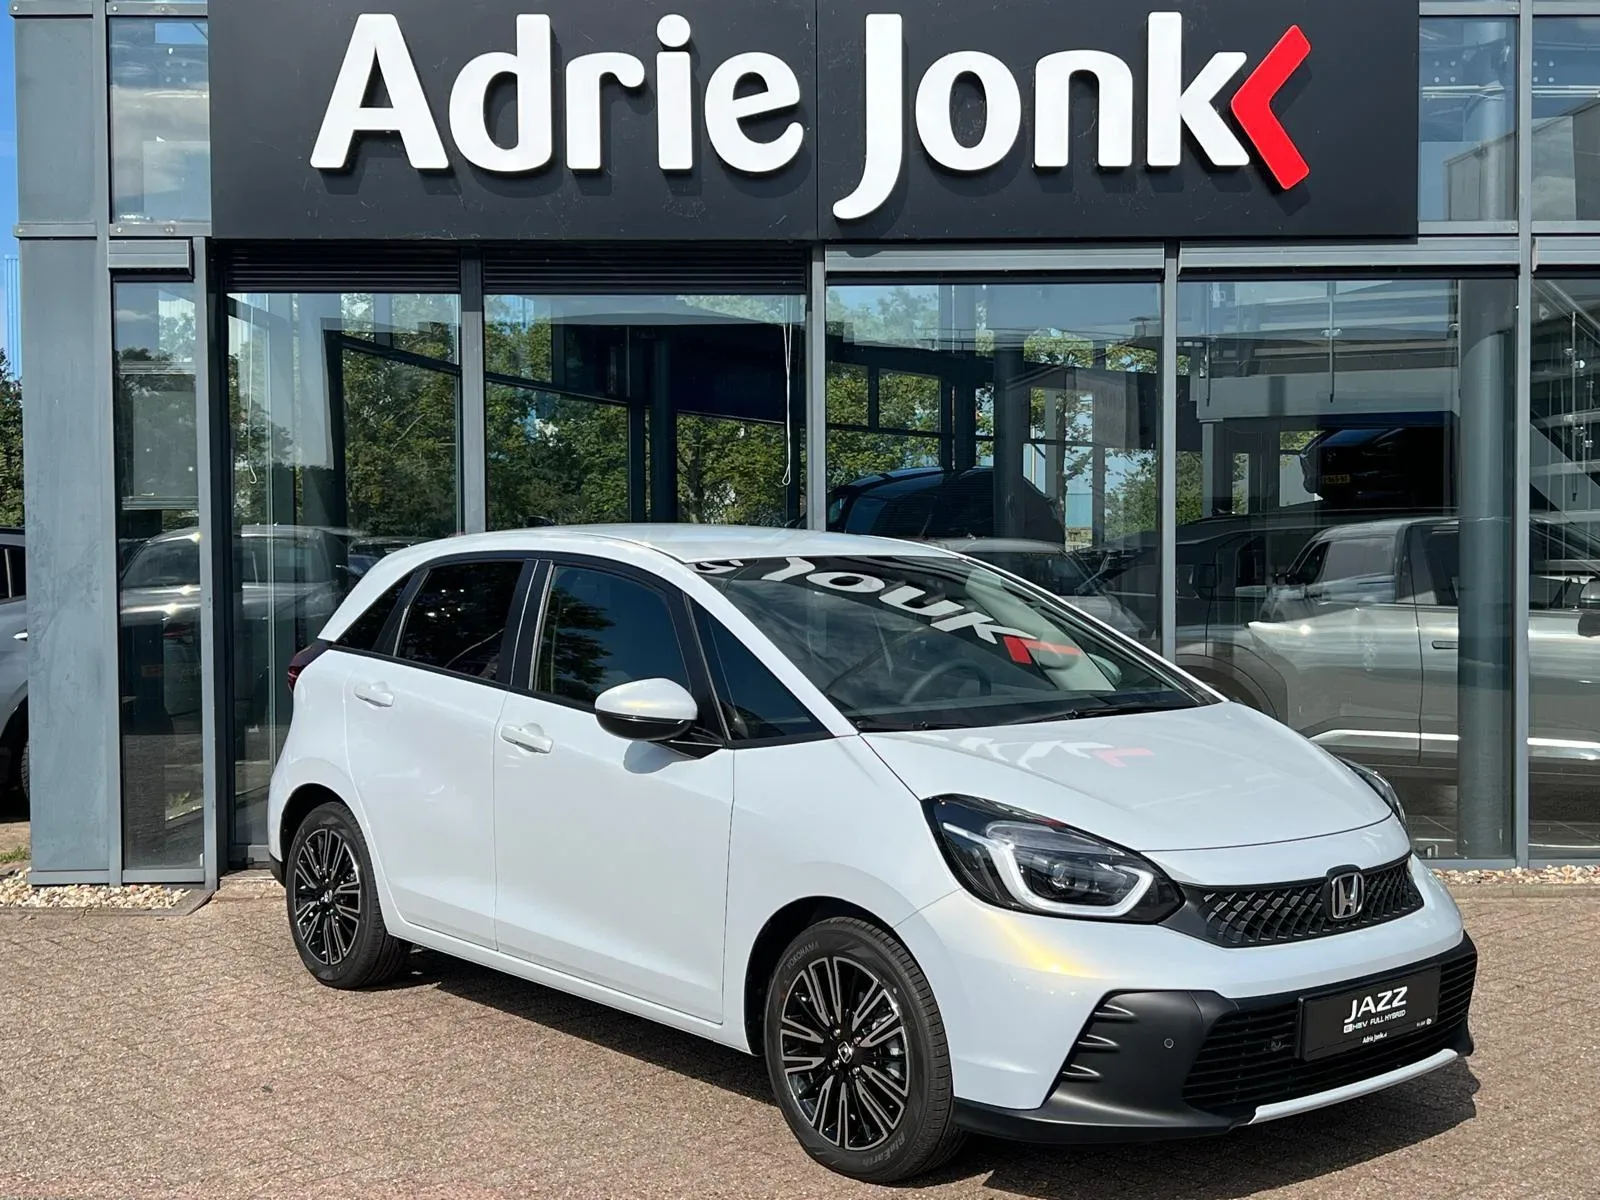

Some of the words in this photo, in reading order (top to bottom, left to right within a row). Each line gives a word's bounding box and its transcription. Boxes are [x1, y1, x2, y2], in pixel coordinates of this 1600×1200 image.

[310, 13, 804, 172] Adrie
[832, 11, 1251, 220] Jonk
[1343, 985, 1408, 1023] JAZZ
[1370, 1015, 1385, 1026] FULL
[1384, 1009, 1406, 1022] HYBRID
